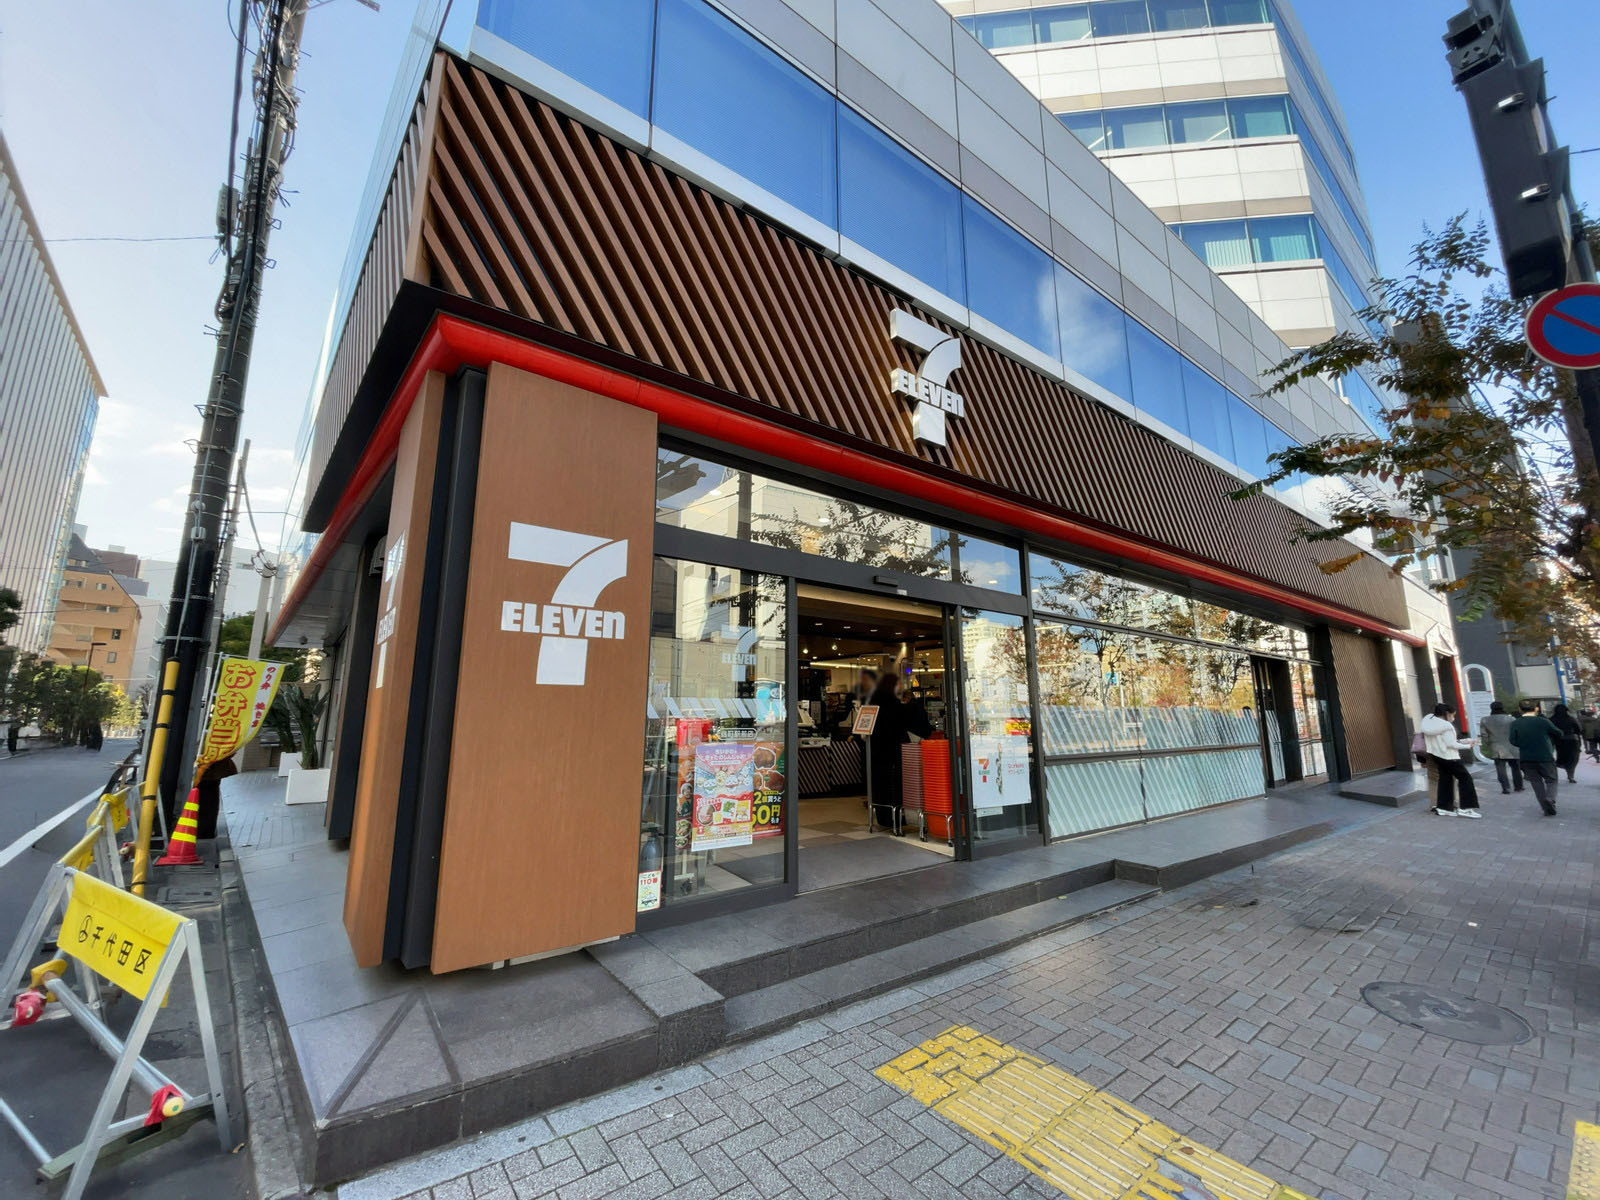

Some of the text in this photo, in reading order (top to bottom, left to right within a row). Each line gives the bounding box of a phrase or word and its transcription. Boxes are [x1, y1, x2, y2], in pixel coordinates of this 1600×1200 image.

[890, 307, 962, 447] 7
[508, 521, 628, 686] 7
[91, 926, 153, 975] 千代田区
